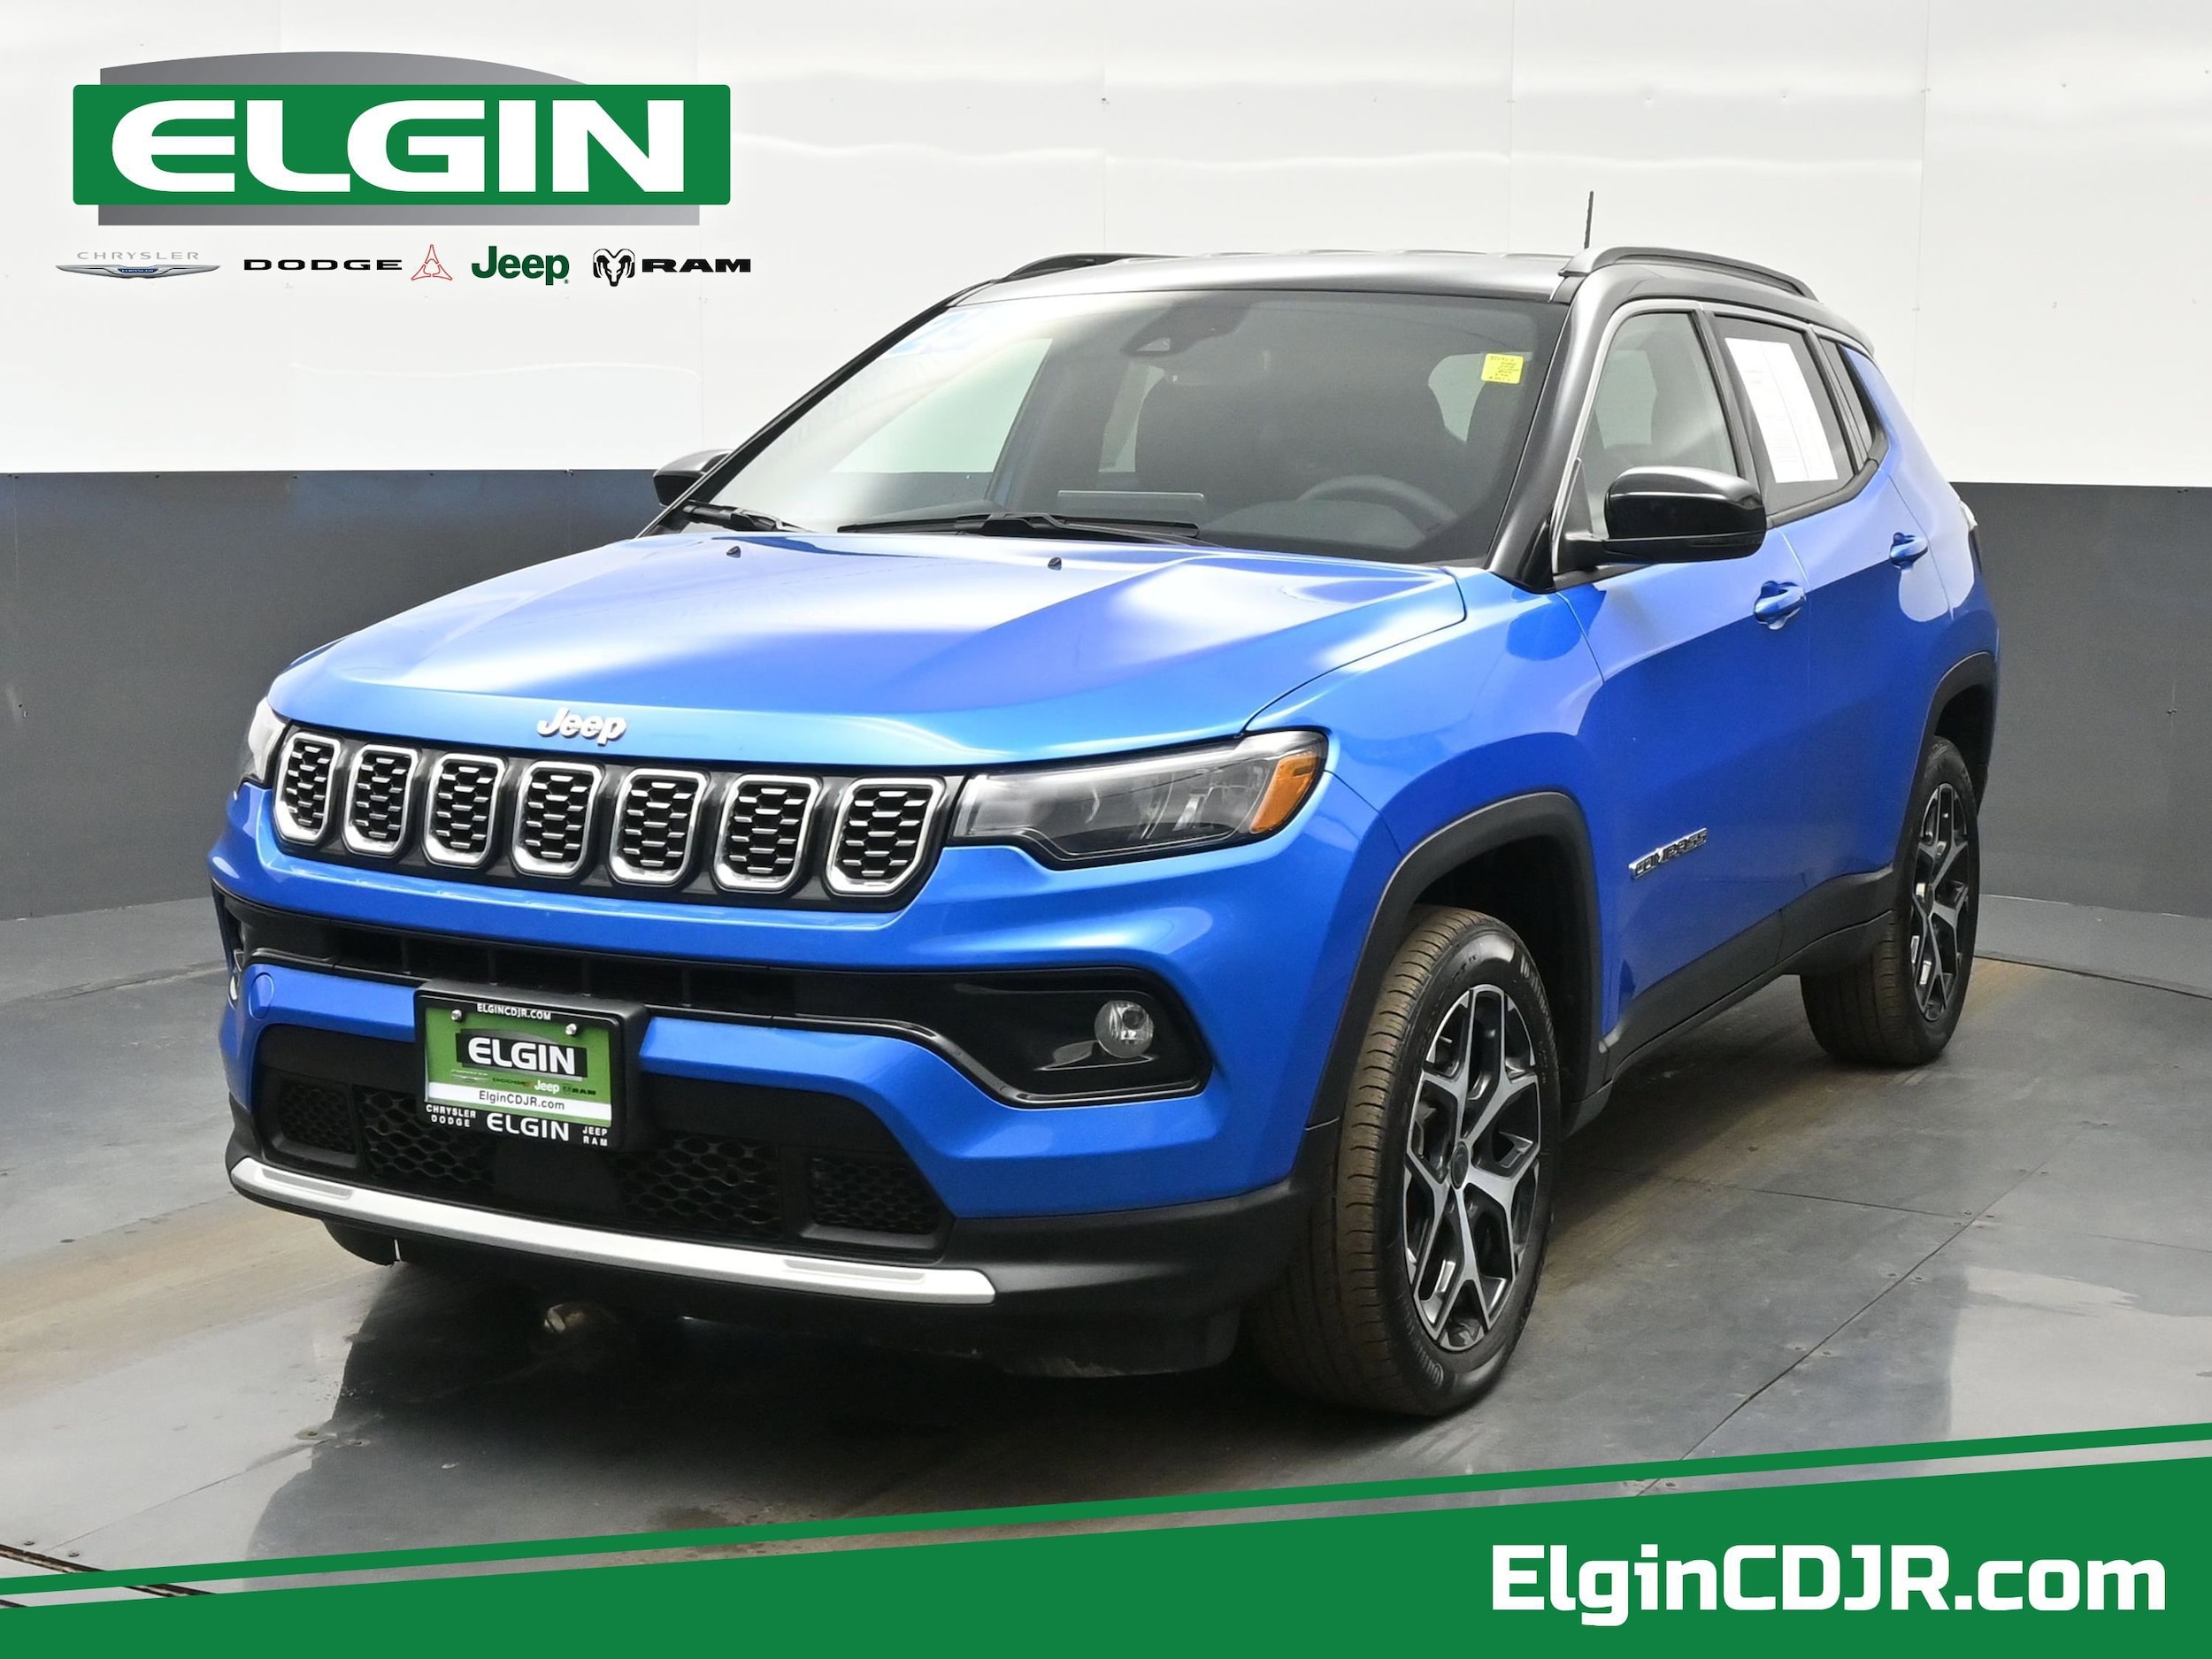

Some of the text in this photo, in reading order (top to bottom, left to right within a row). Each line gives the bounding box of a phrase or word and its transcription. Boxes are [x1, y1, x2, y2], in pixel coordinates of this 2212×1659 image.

[537, 707, 626, 746] Jeep
[477, 1003, 551, 1020] ELGINCDJR.COM
[468, 1037, 575, 1075] ELGIN
[534, 1079, 560, 1094] Jeep
[479, 1089, 565, 1110] ElginCDJR.com
[426, 1103, 476, 1119] CHRYSLER
[431, 1115, 471, 1128] DODGE
[487, 1112, 569, 1142] ELGIN
[582, 1125, 608, 1137] JEEP
[583, 1136, 608, 1147] RAM
